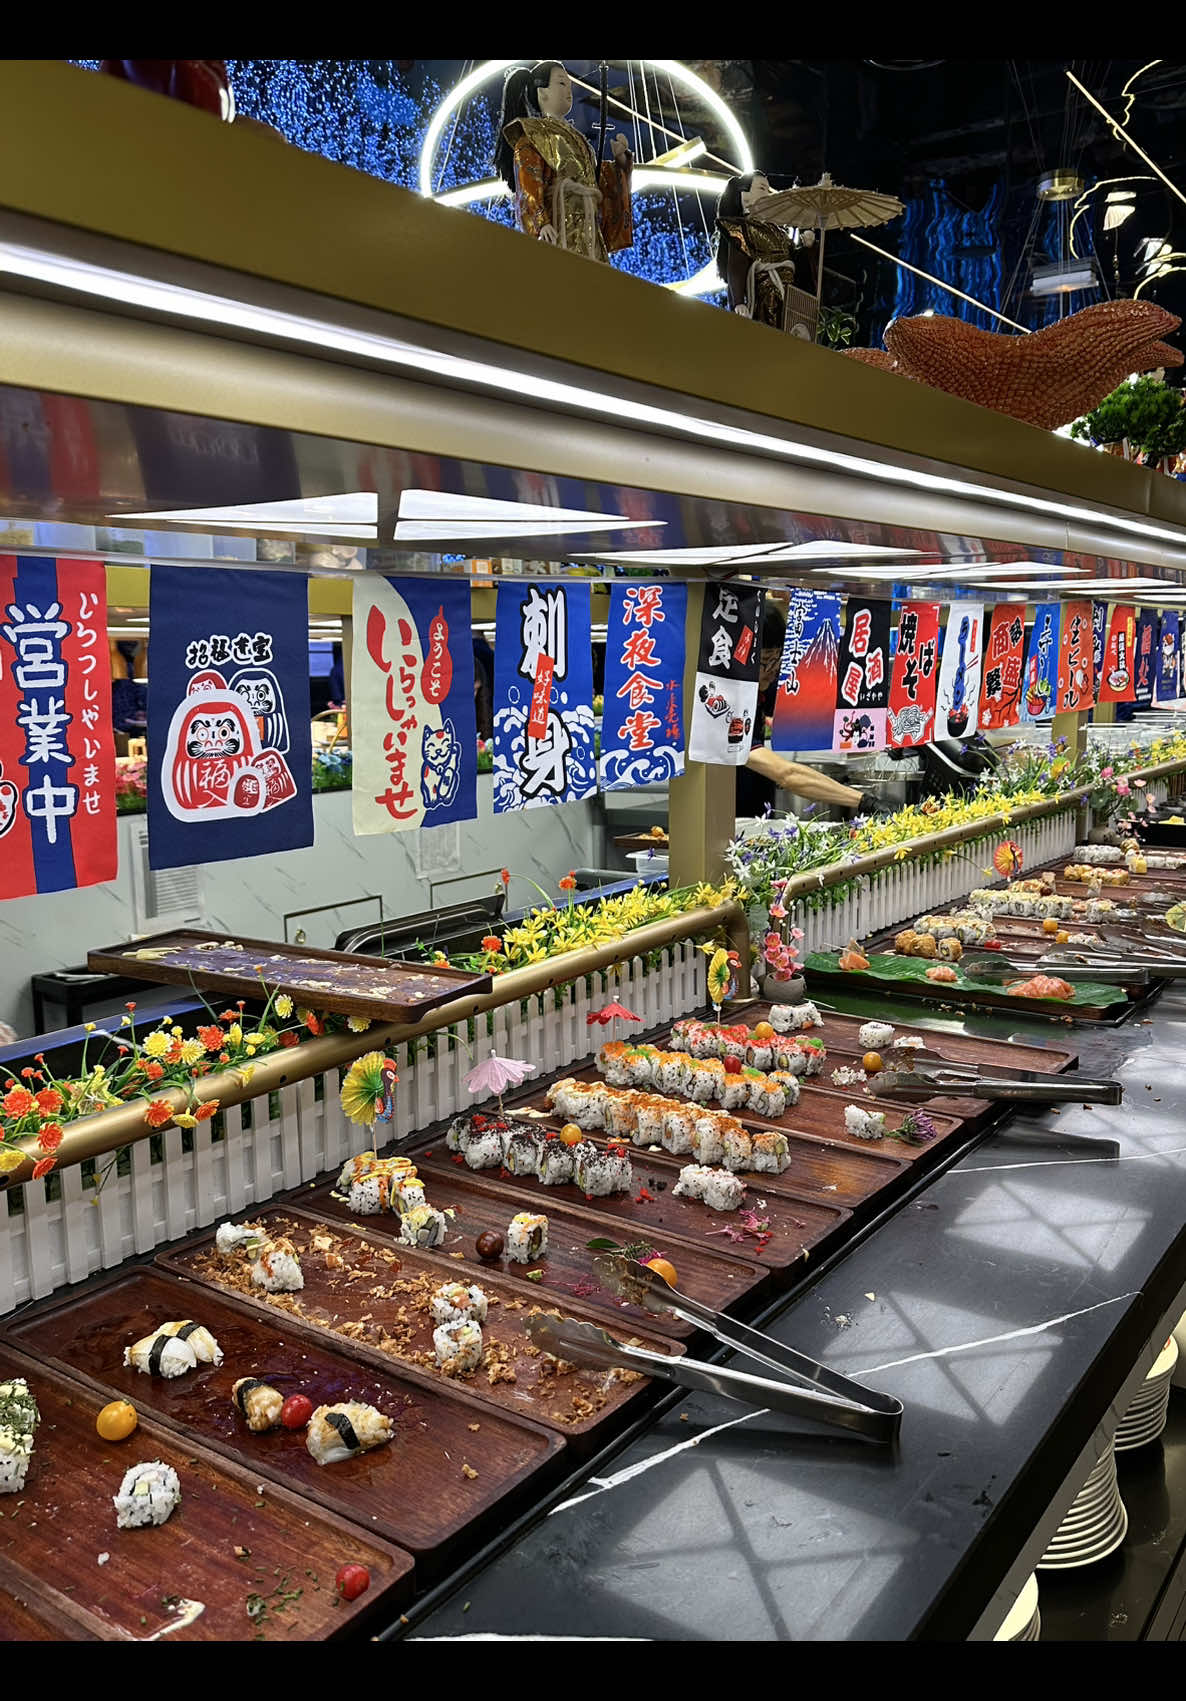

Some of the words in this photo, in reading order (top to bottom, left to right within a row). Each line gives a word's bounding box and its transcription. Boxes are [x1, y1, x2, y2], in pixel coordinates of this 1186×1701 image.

[366, 604, 418, 820] いらっしゃいませ
[427, 622, 444, 697] ようこそ
[520, 584, 571, 796] 刺身
[532, 668, 552, 725] 好味道
[617, 585, 666, 751] 深夜食堂
[785, 600, 808, 696] 富士山
[841, 608, 884, 707] 居酒屋
[2, 603, 76, 844] 営業中
